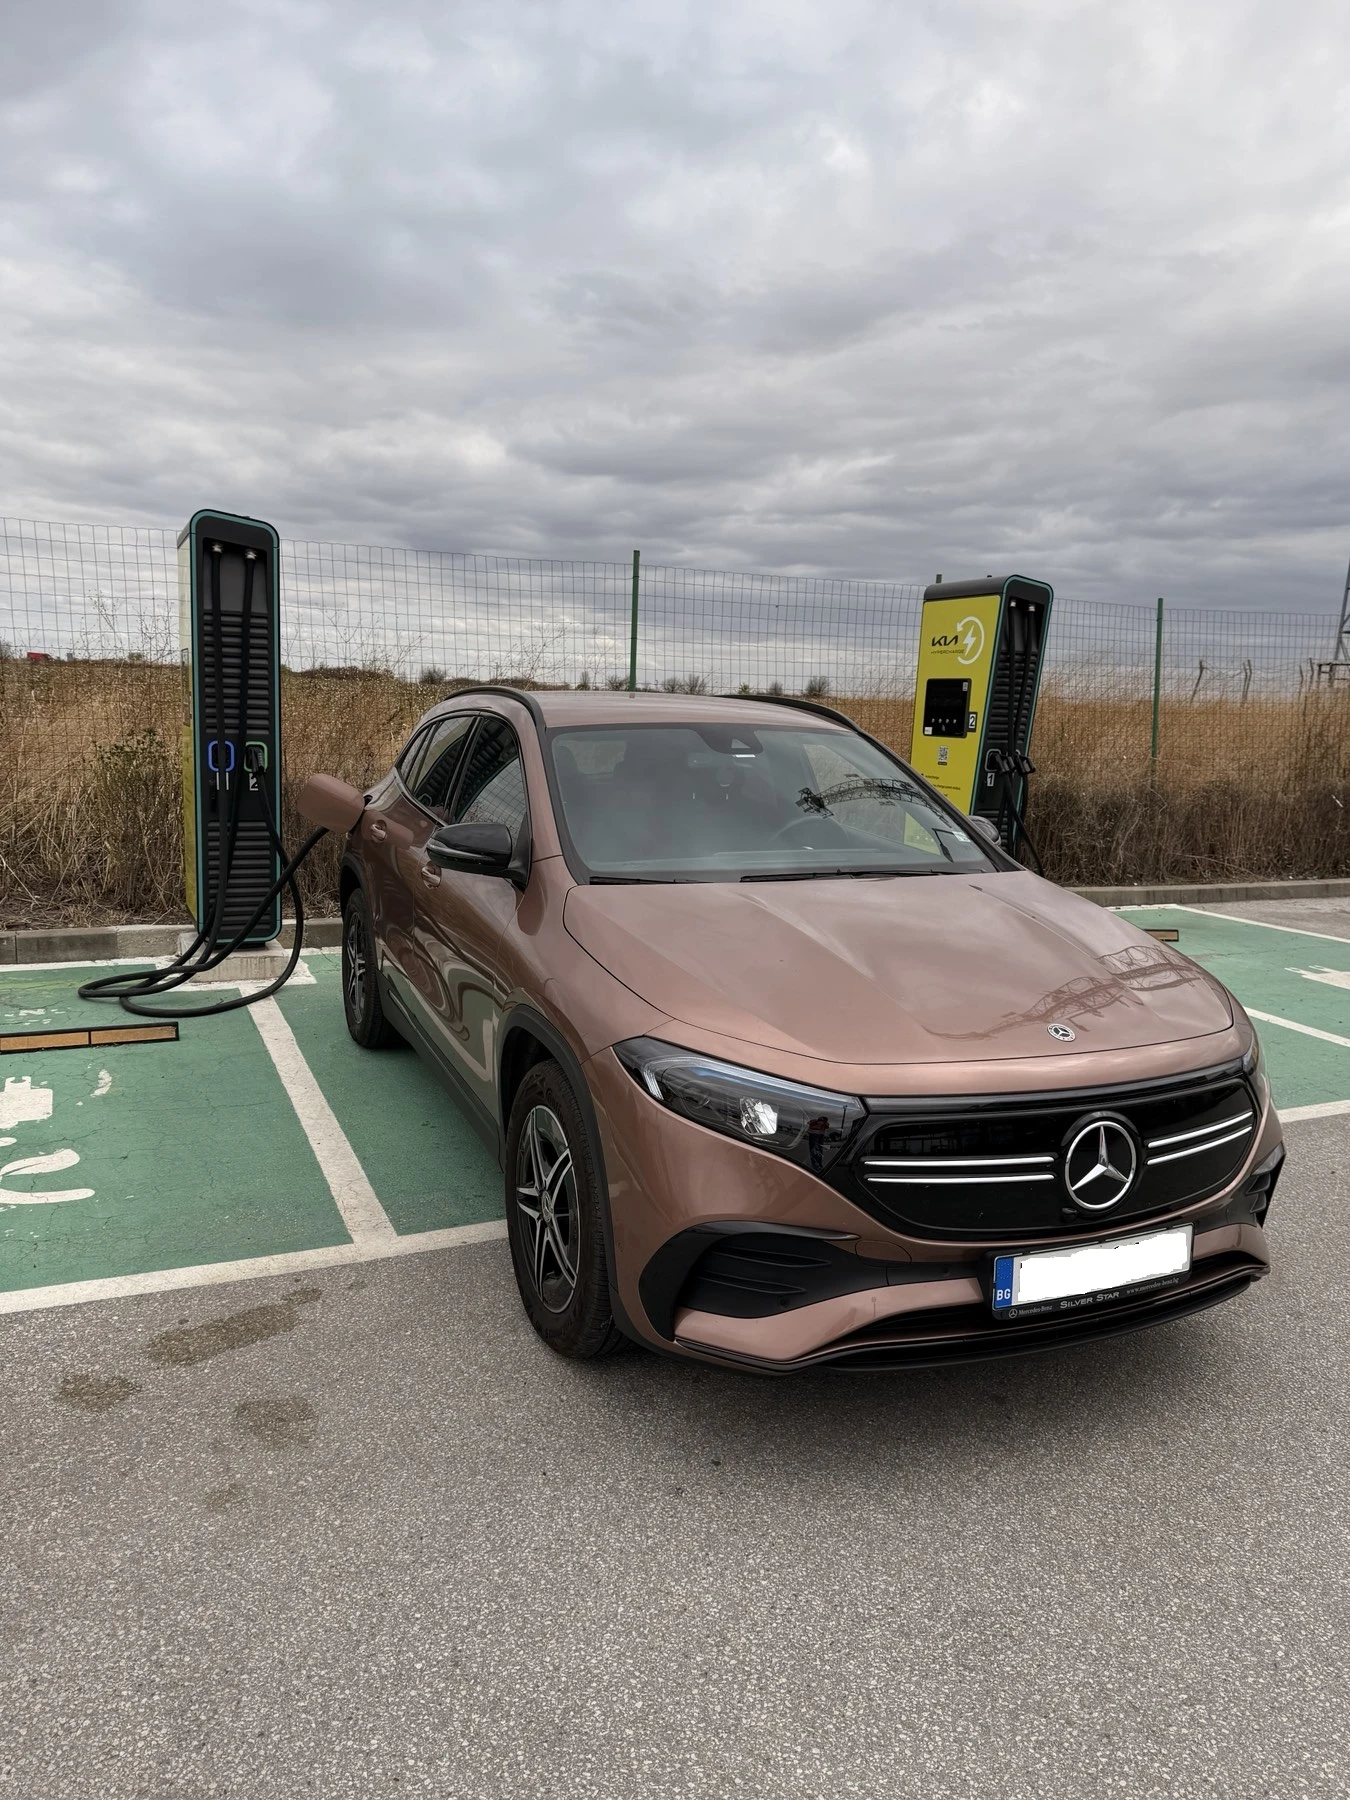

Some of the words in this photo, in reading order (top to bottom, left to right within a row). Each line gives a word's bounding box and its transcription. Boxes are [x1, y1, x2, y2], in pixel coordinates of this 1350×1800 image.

[931, 635, 959, 647] KIA
[970, 716, 976, 727] 2
[996, 1288, 1011, 1301] BG
